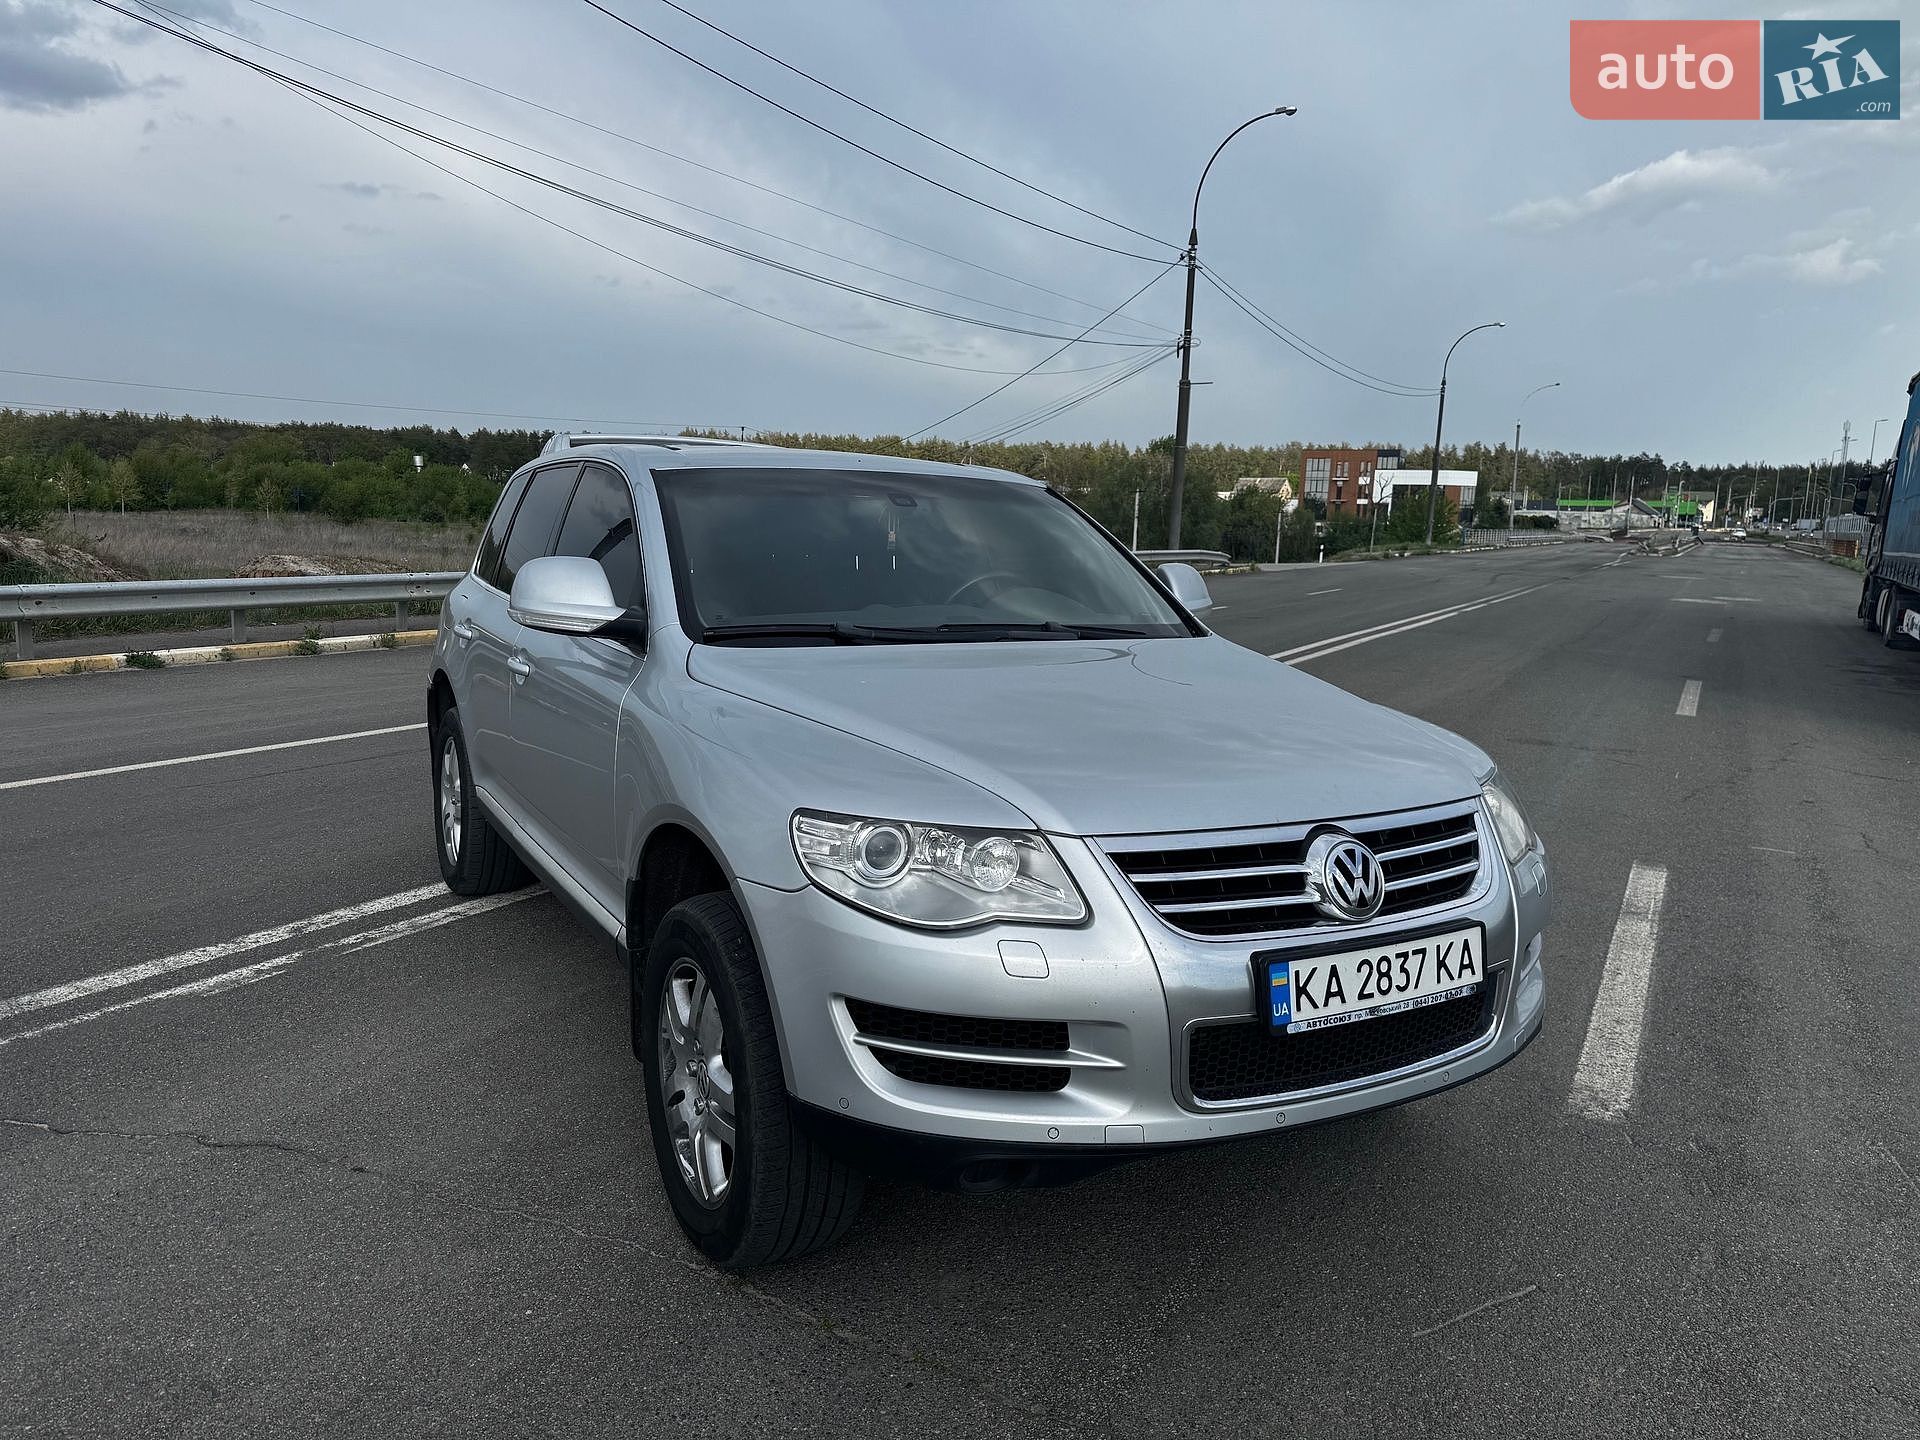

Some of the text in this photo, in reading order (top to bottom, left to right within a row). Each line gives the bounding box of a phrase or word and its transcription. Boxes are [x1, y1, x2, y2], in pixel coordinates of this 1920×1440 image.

[1294, 938, 1476, 1012] KA 2837 KA
[1273, 1003, 1289, 1017] UA
